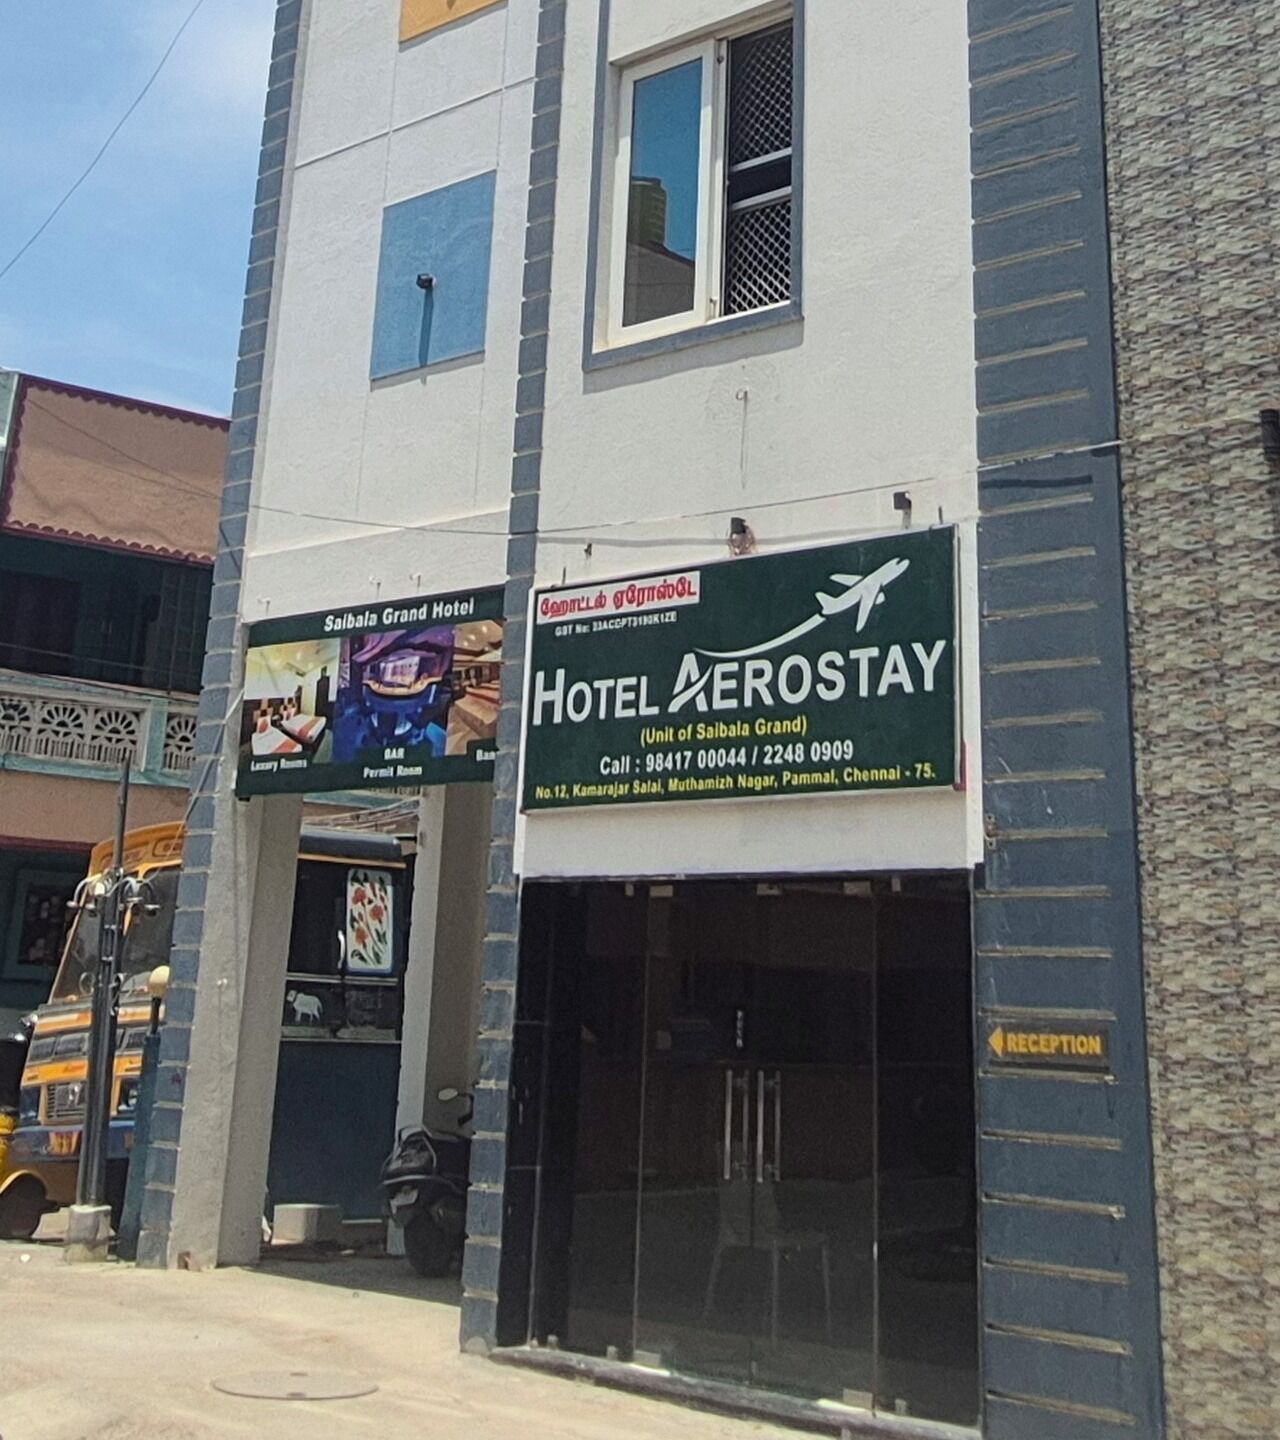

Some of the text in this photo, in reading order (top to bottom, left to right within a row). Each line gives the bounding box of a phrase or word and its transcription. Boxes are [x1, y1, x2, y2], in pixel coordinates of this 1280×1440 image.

[324, 597, 474, 632] Saibala Grand Hotel
[540, 576, 697, 619] ஹோட்டல் ஏரோஸ்டே
[532, 639, 946, 726] HOTEL AEROSTAY
[640, 715, 807, 747] (Unit of Saibala Grand)
[600, 755, 630, 775] Call
[646, 751, 692, 772] 98417
[697, 747, 746, 768] 00044
[763, 742, 804, 765] 2248
[811, 739, 854, 762] 0909
[573, 781, 629, 798] Kamarajar
[668, 776, 733, 792] Muthamizh
[738, 773, 778, 791] Nagar,
[783, 769, 839, 786] Pammal,
[843, 764, 900, 782] Chennai
[1006, 1032, 1102, 1055] RECEPTION
